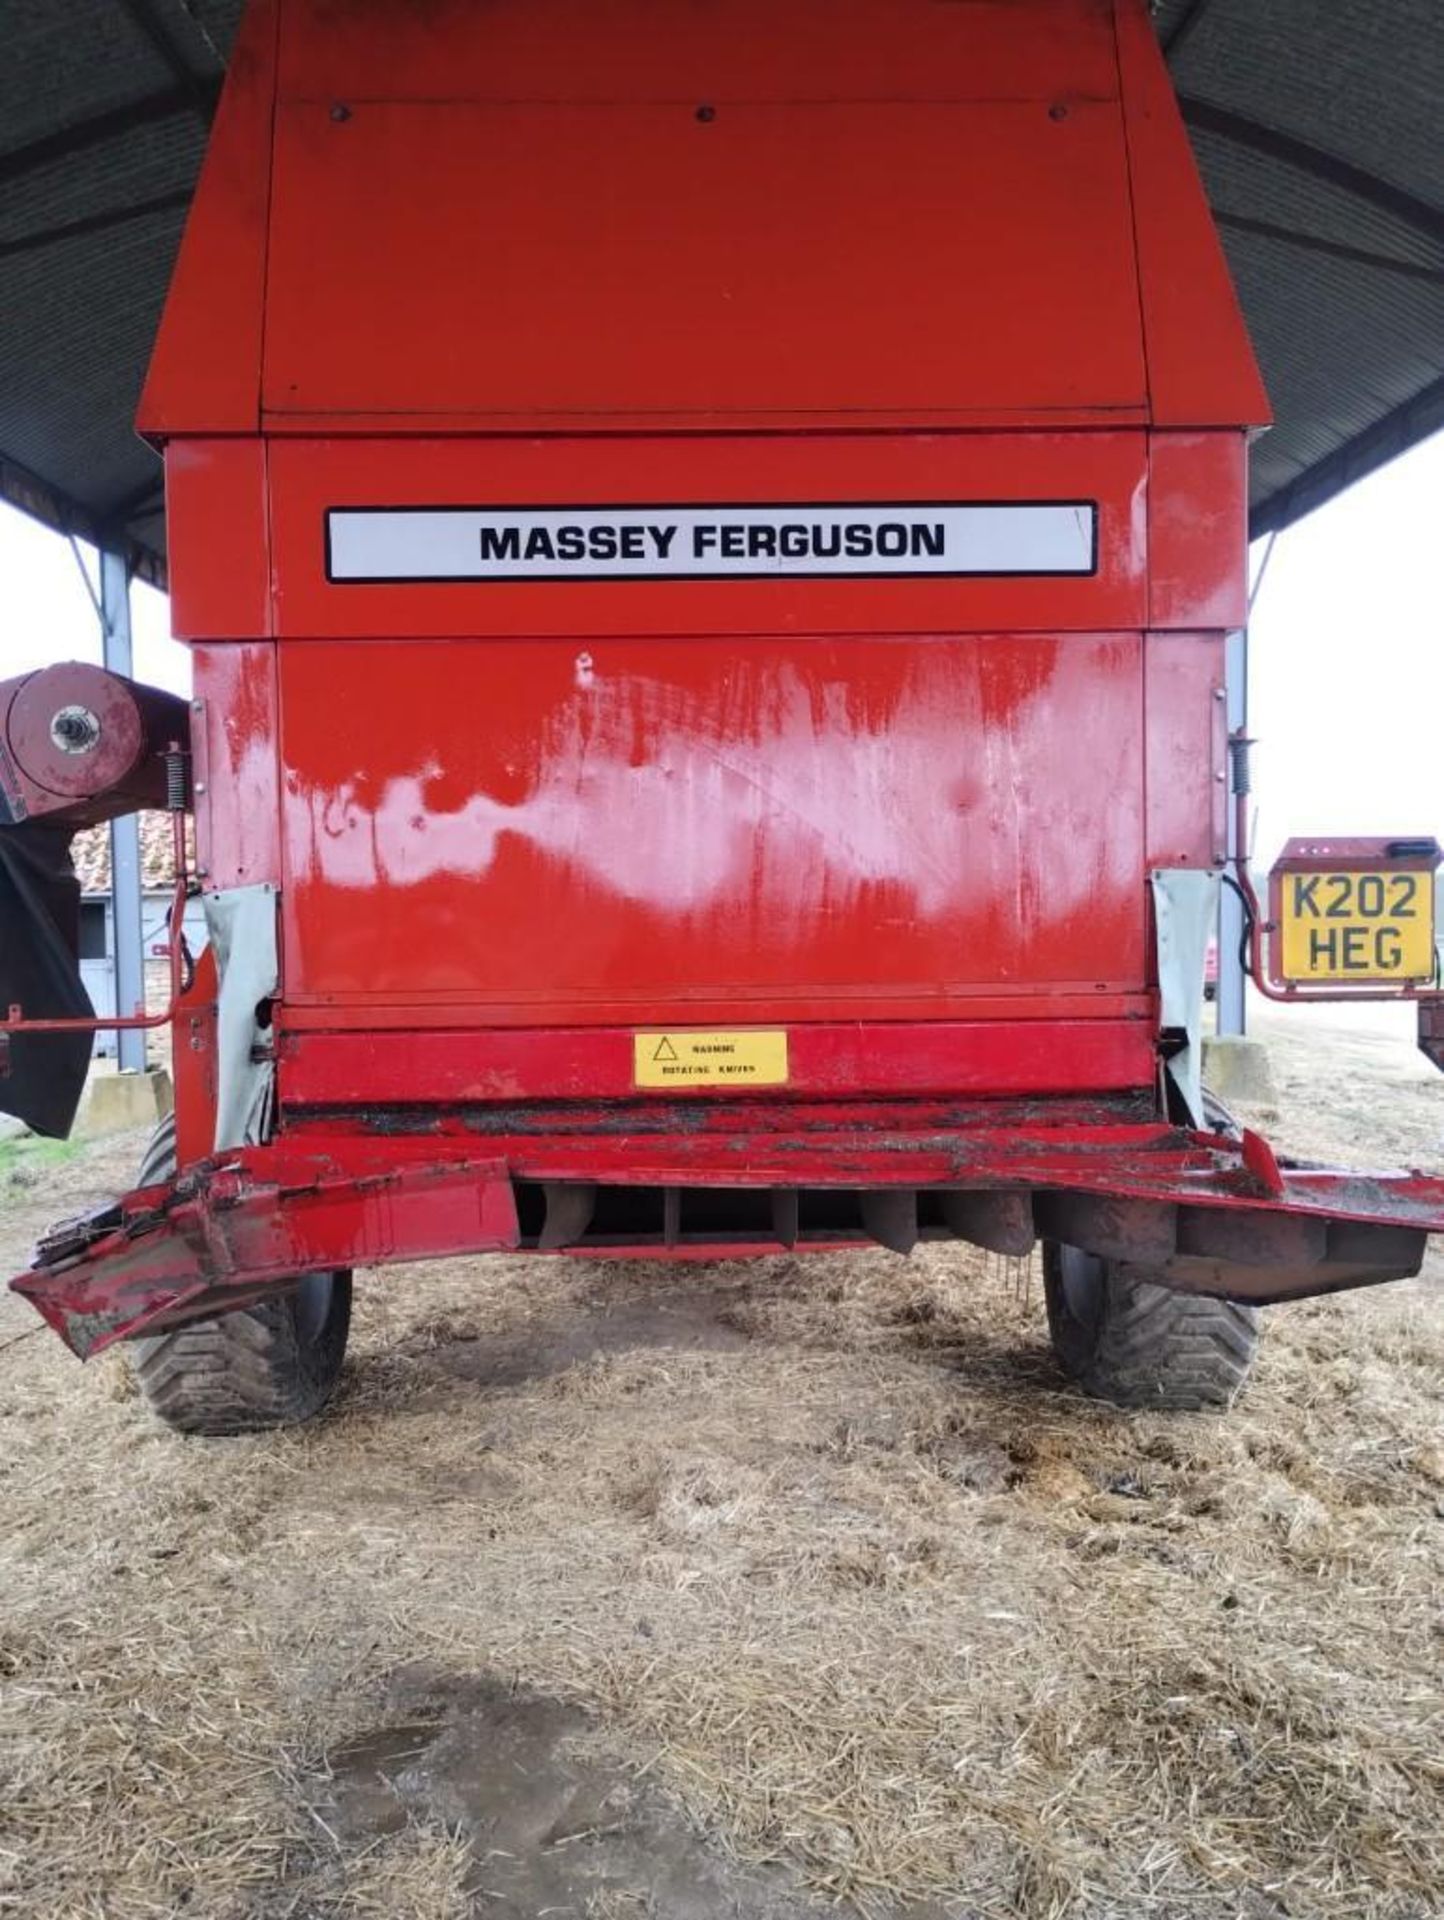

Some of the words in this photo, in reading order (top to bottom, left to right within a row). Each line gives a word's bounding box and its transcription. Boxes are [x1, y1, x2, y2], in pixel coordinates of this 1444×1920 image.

[480, 526, 676, 560] MASSEY
[692, 523, 946, 558] FERGUSON
[1295, 876, 1415, 917] K202
[1310, 927, 1402, 970] HEG
[692, 1045, 735, 1054] WARNING
[662, 1066, 710, 1075] ROTATING
[719, 1065, 756, 1074] KNIVES
